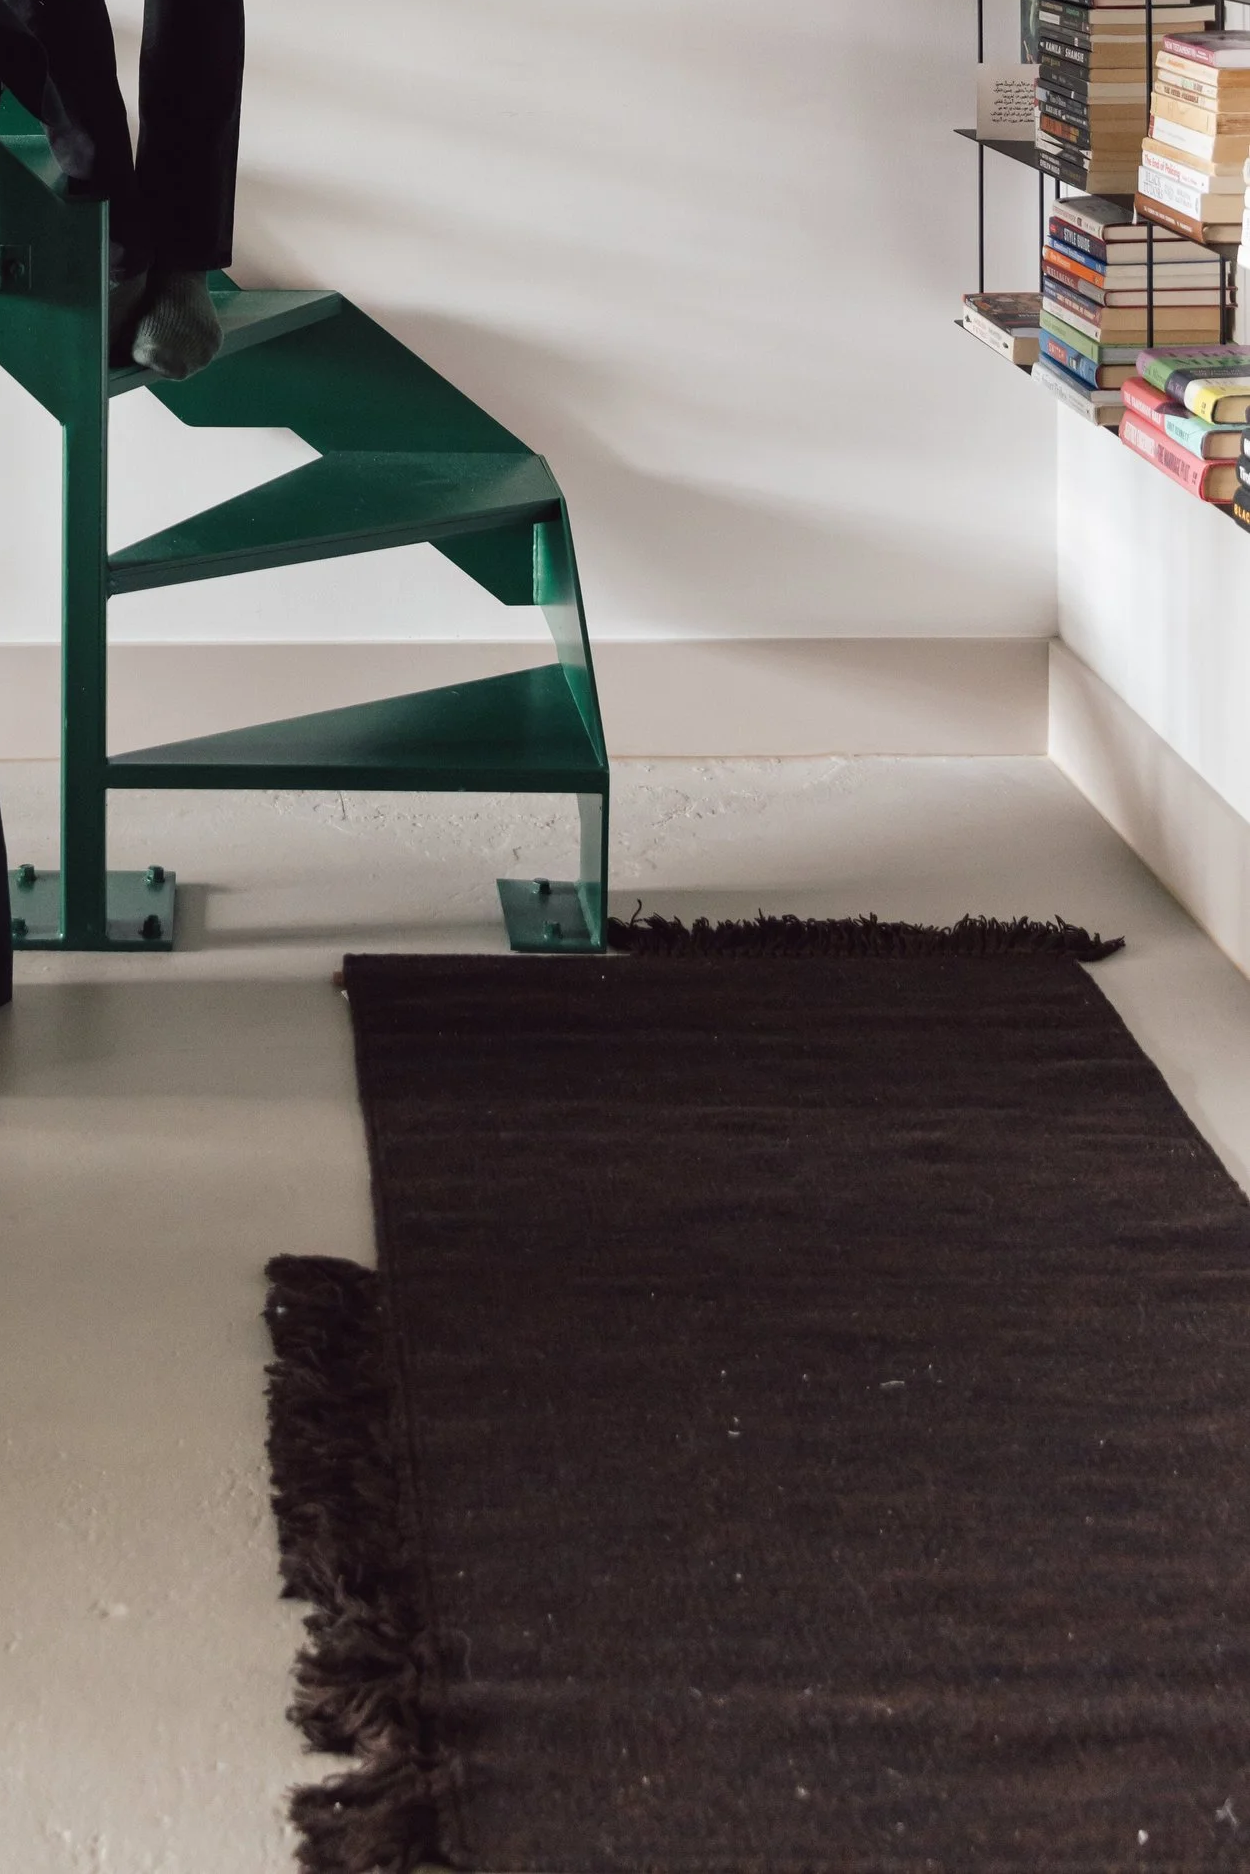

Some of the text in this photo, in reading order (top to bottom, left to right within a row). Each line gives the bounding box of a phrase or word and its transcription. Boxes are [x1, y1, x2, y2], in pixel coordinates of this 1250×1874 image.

[1045, 41, 1085, 63] KAMILA SHAMSIE
[1063, 227, 1091, 253] STYLE GUIDE
[1046, 265, 1076, 287] WELLBEING
